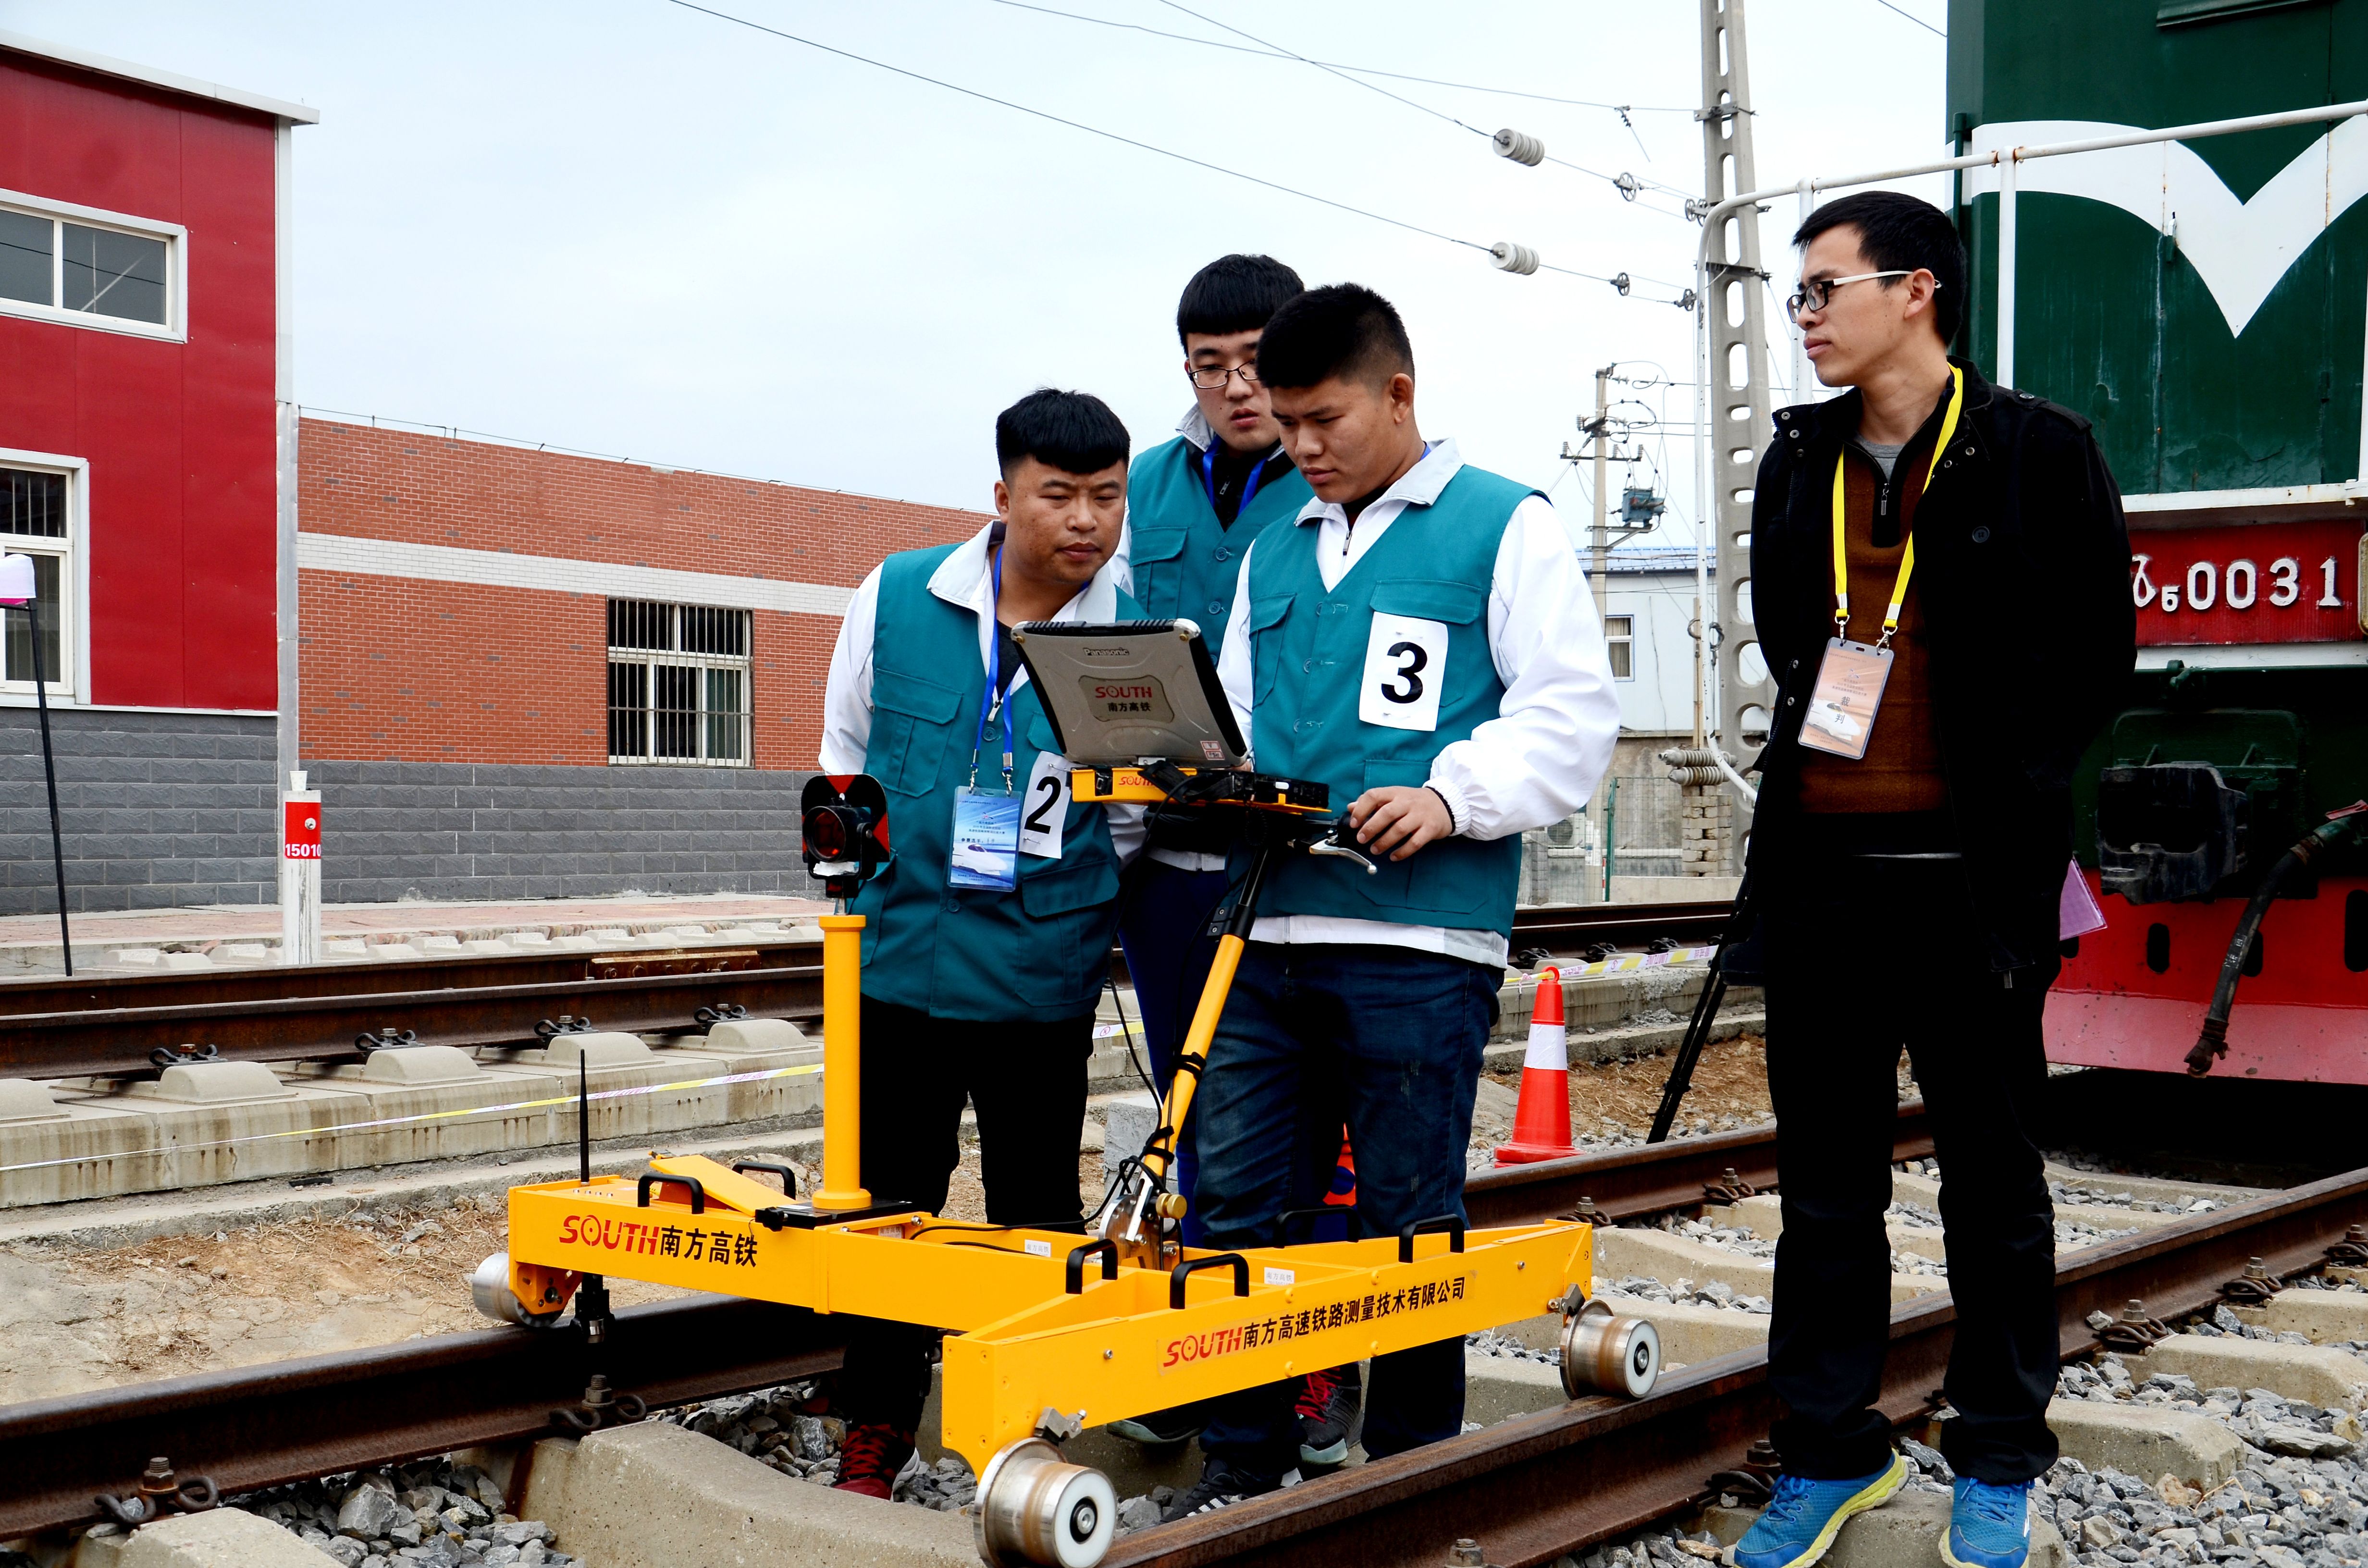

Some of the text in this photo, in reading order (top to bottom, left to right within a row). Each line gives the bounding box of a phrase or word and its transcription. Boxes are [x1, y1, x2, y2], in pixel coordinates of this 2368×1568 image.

[1083, 648, 1130, 656] Panasonic
[1381, 641, 1428, 704] 3
[1095, 686, 1152, 698] SOUTH
[1107, 702, 1151, 712] 南方高铁
[1024, 776, 1061, 834] 2
[285, 844, 321, 857] 15010
[559, 1215, 757, 1268] SOUTH 南方高铁
[1163, 1276, 1465, 1367] SOUTH 南方高速铁路测量技术有限公司
